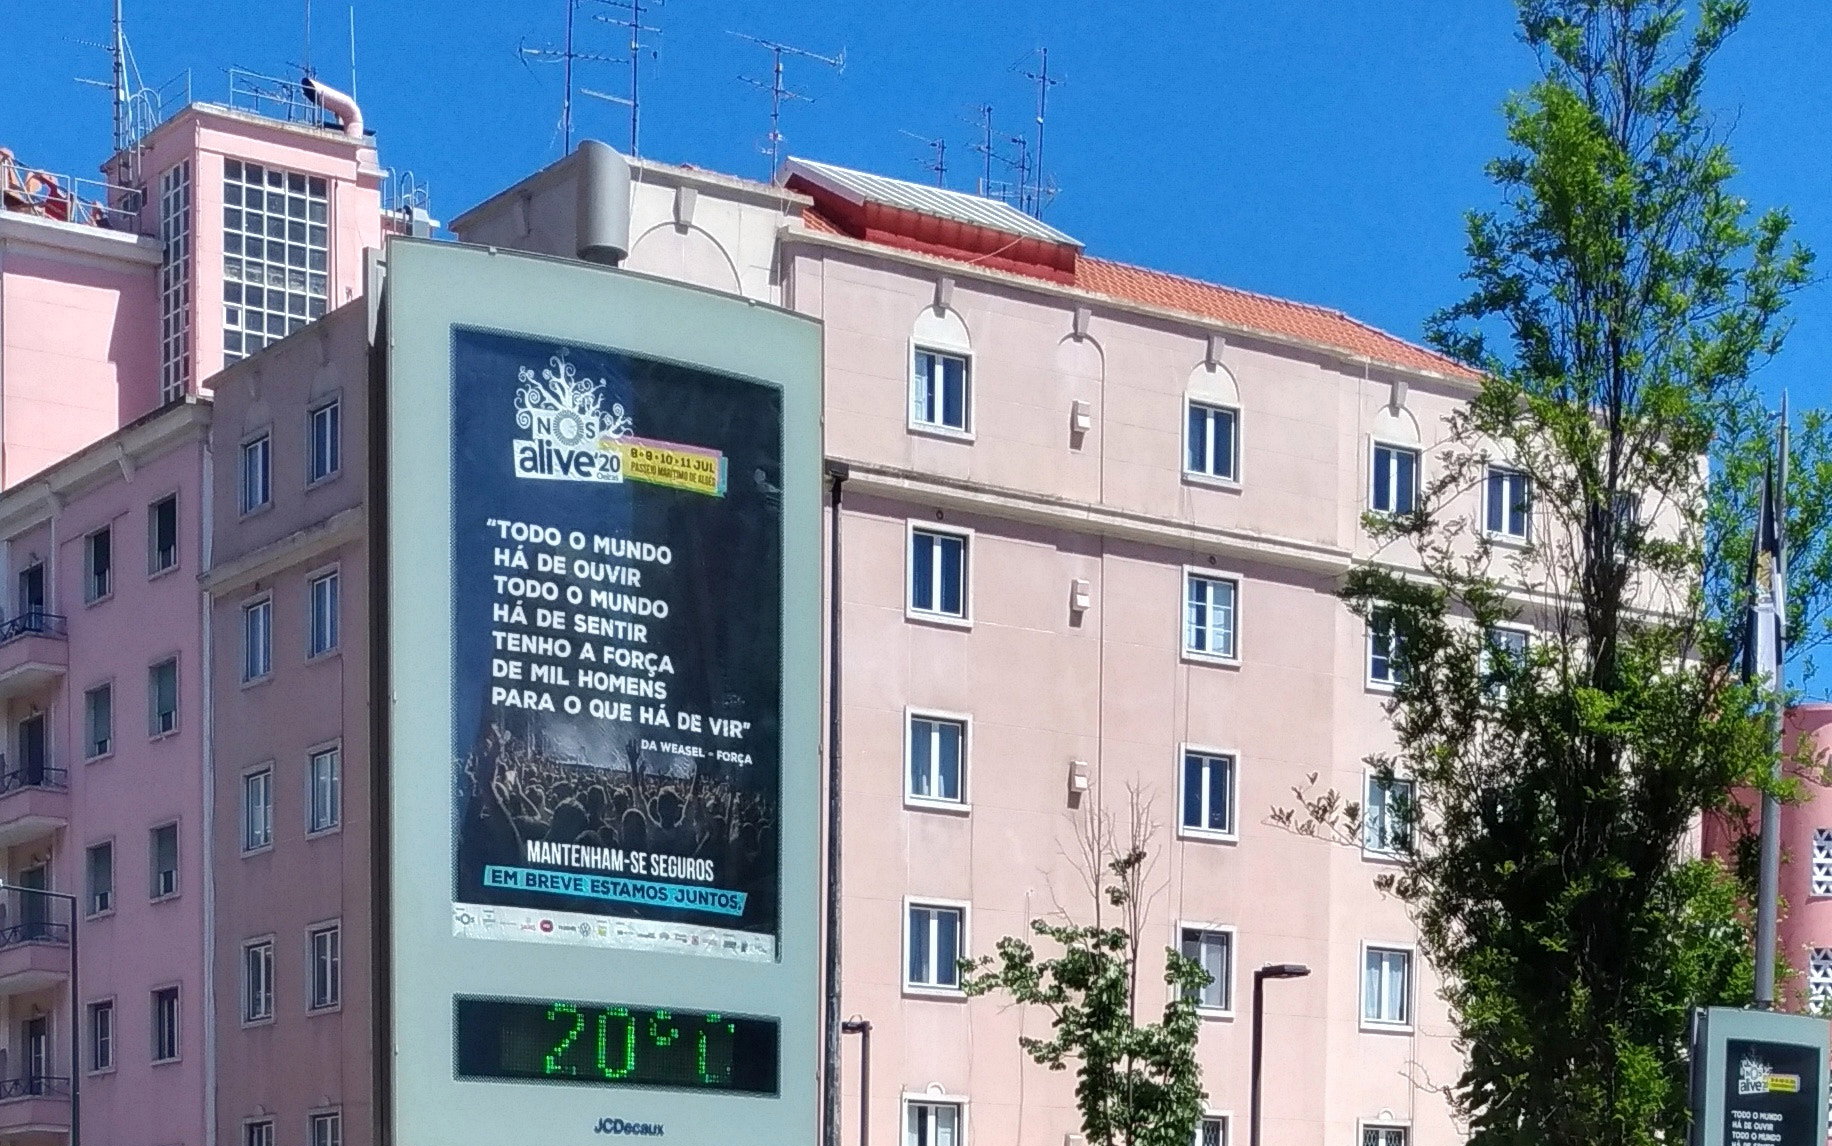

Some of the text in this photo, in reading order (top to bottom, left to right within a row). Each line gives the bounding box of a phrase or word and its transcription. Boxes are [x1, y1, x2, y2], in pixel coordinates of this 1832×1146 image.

[537, 409, 596, 447] NOS
[693, 459, 715, 473] JUL
[494, 545, 641, 588] HÁ DE OUVIR
[569, 531, 586, 550] O
[593, 534, 672, 565] MUNDO
[493, 575, 669, 619] TODO O MUNDO
[493, 600, 647, 643] HÁ DE SENTIR
[492, 630, 675, 677] TENHO A FORÇA
[492, 658, 668, 700] DE MIL HOMENS
[492, 687, 556, 713] PARA
[563, 695, 582, 714] O
[589, 698, 632, 722] QUE
[640, 704, 670, 728] HÁ
[677, 711, 702, 733] DE
[641, 738, 658, 752] DA
[660, 740, 706, 759] WEASEL
[716, 749, 753, 768] FORÇA
[526, 839, 714, 882] MANTENHAM-SE SEGUROS
[491, 868, 743, 911] EM BREVE ESTAMOS JUNTOS.
[594, 1117, 664, 1137] JCDecaux
[1732, 1119, 1774, 1131] HÁ DE OUVIR
[1732, 1131, 1781, 1142] TODO O MUNDO
[1752, 1112, 1758, 1120] O
[1760, 1113, 1783, 1121] MUNDO
